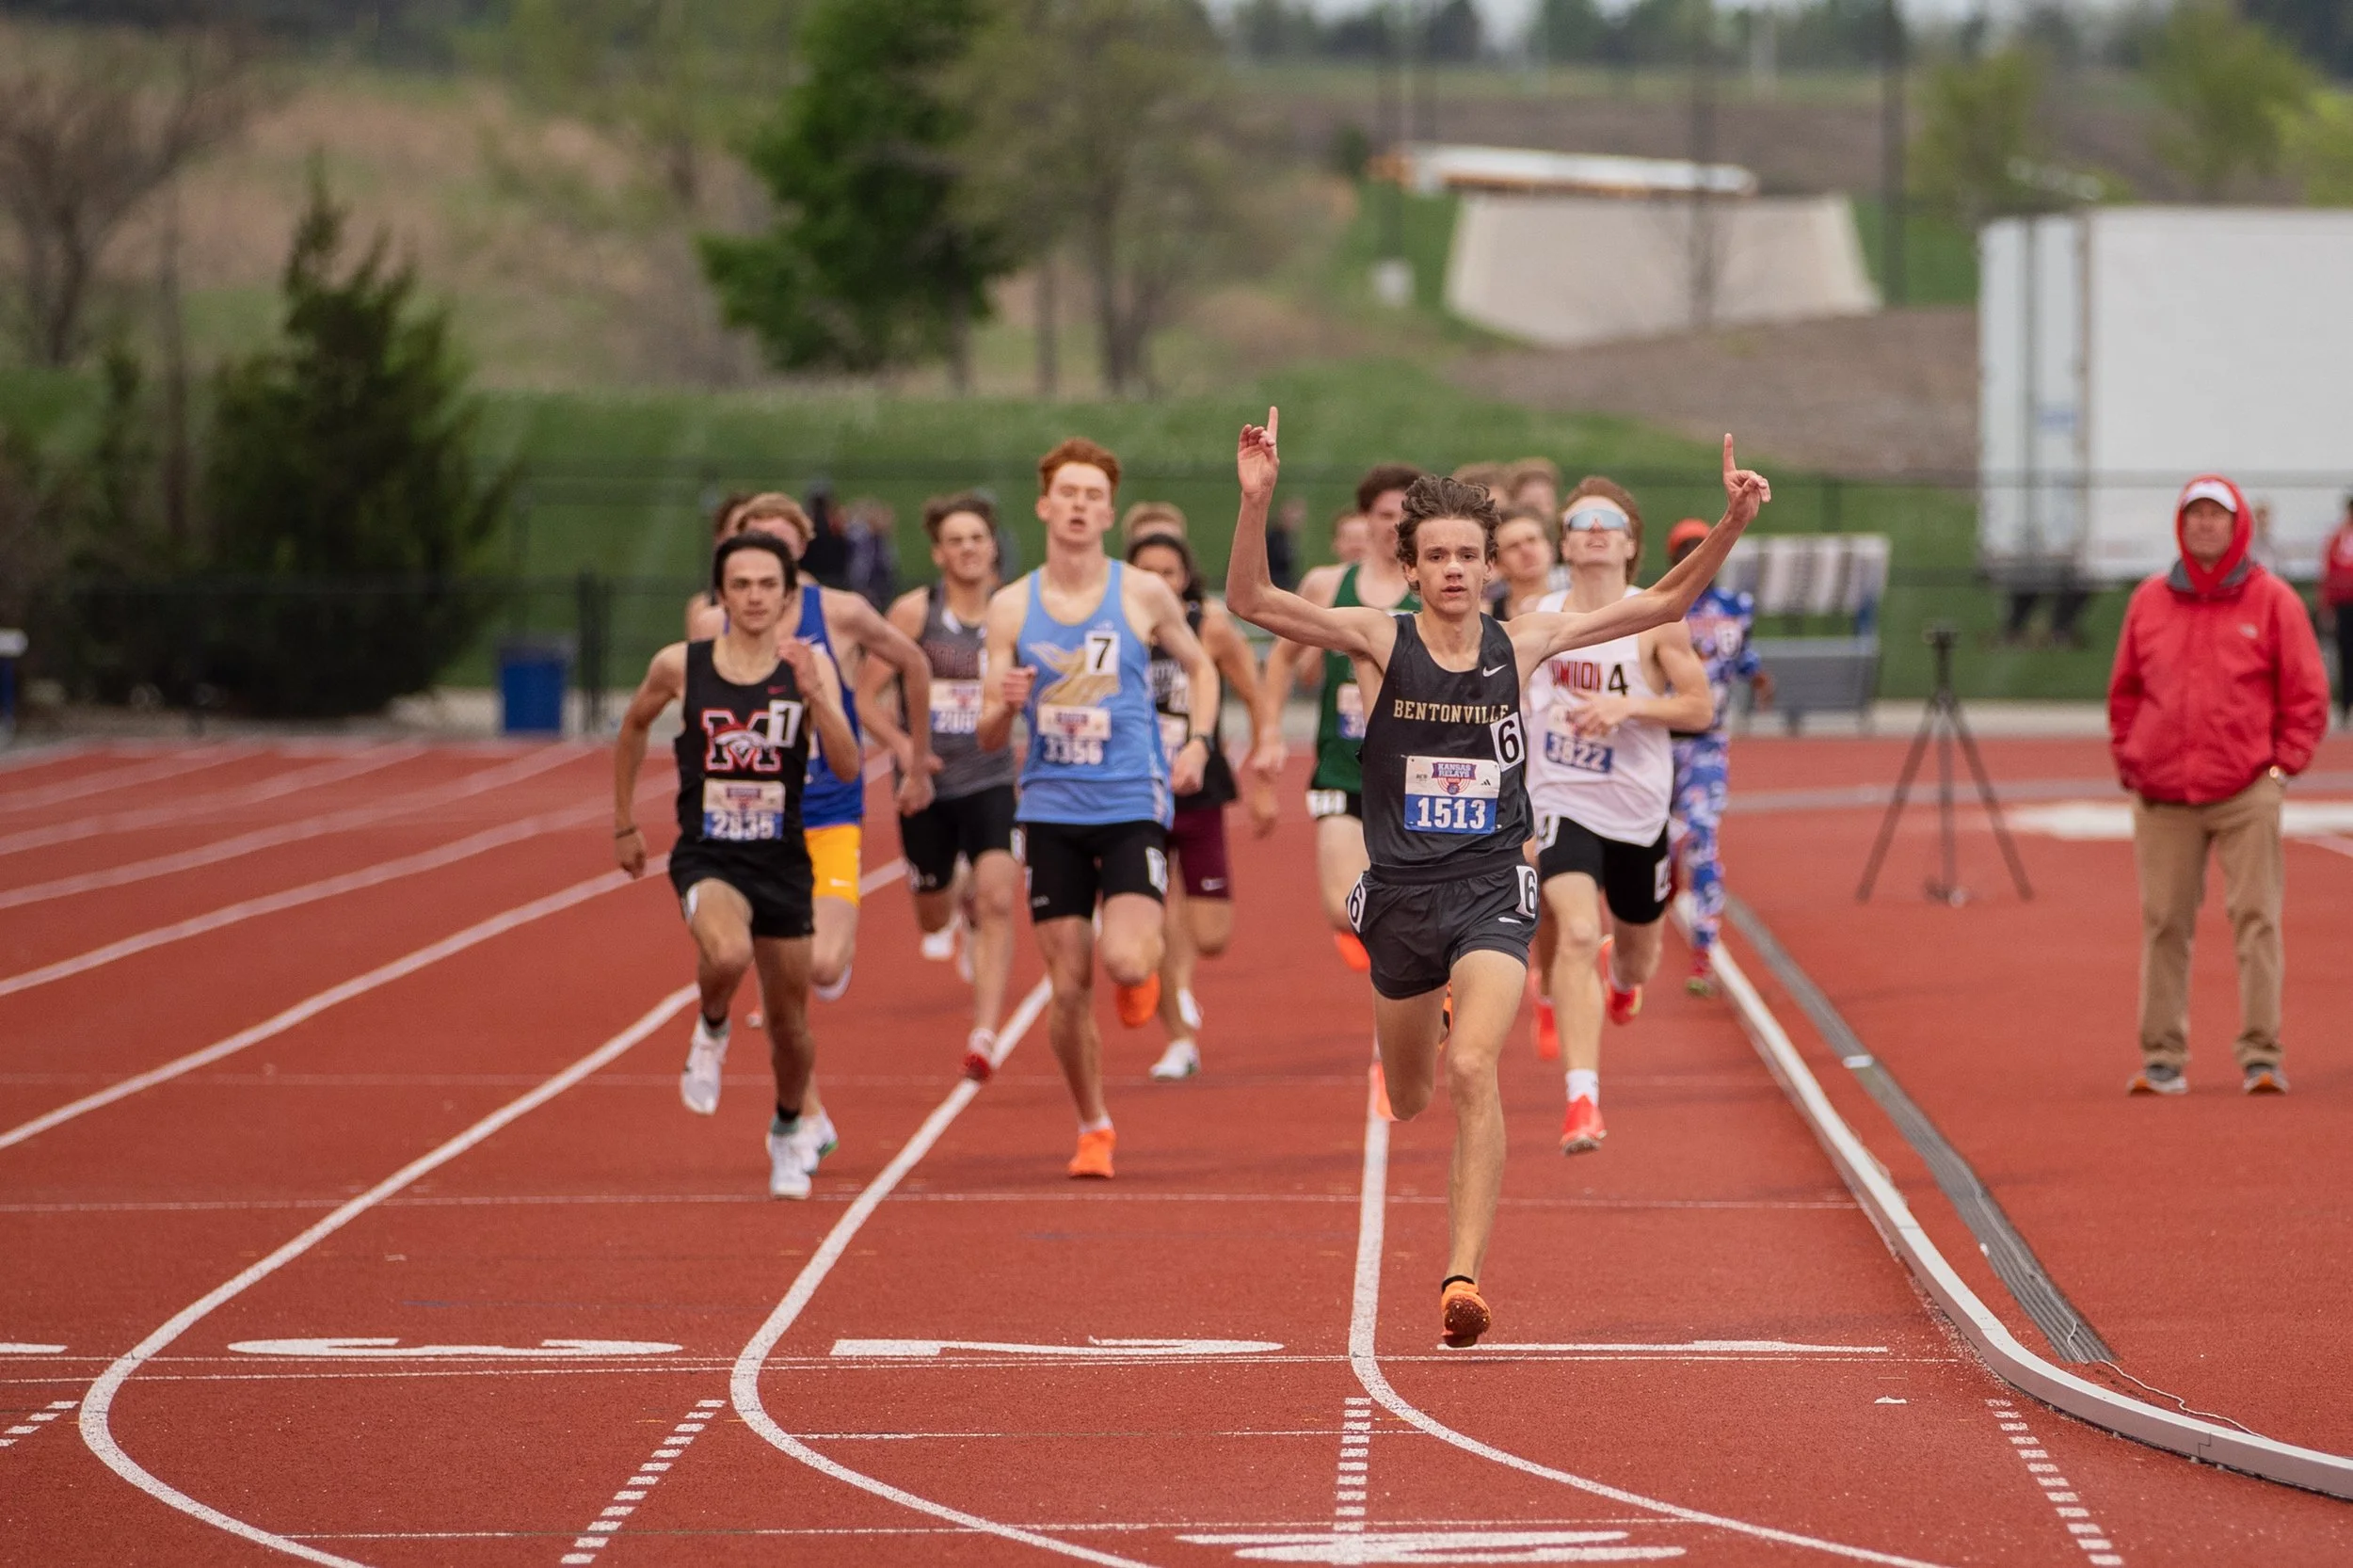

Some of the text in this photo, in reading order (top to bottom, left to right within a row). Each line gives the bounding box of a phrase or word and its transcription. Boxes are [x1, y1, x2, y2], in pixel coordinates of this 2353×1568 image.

[1093, 637, 1112, 670] 7
[1608, 664, 1629, 696] 4
[777, 708, 792, 741] 1
[1393, 698, 1509, 725] BENTONVILLE
[1497, 719, 1521, 764] 6
[1417, 797, 1486, 829] 1513
[1350, 884, 1363, 924] 6
[1524, 871, 1538, 914] 6
